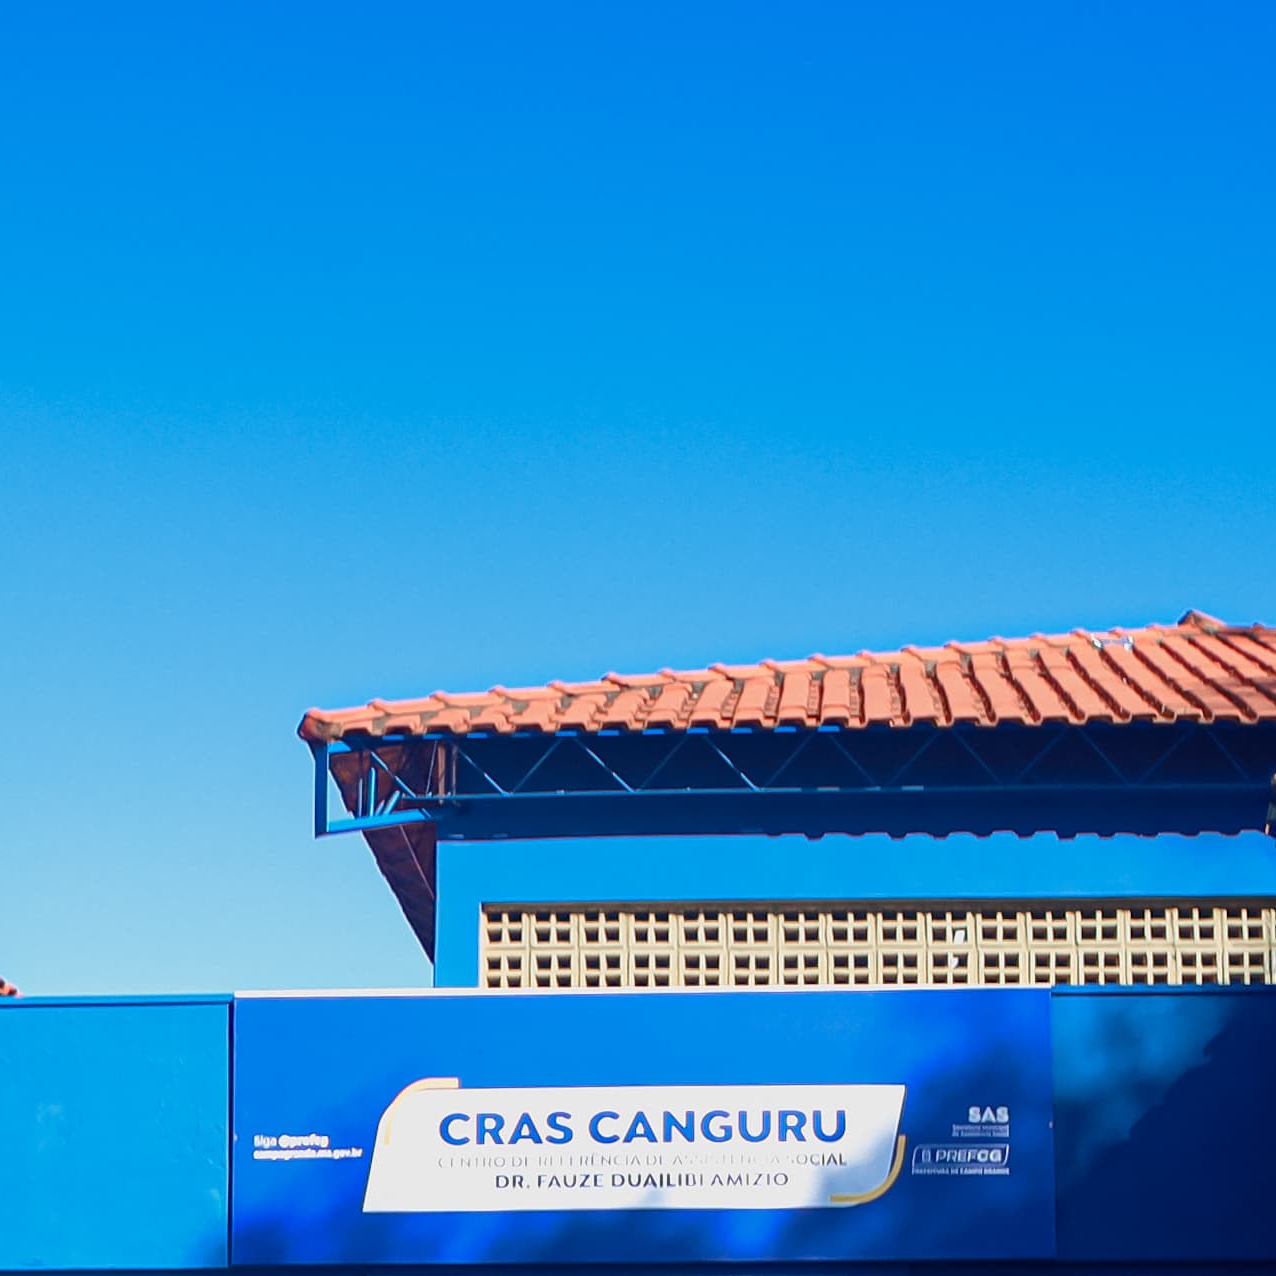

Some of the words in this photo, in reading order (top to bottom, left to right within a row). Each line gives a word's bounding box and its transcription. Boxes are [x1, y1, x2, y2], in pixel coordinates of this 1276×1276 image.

[968, 1106, 1009, 1123] SAS
[439, 1111, 573, 1146] CRAS
[588, 1110, 847, 1144] CANGURU
[935, 1148, 1002, 1163] PREFCG
[495, 1174, 531, 1189] DR.
[537, 1173, 604, 1188] FAUZE
[611, 1172, 704, 1189] DUAILIBI
[710, 1172, 789, 1187] AMIZIO
